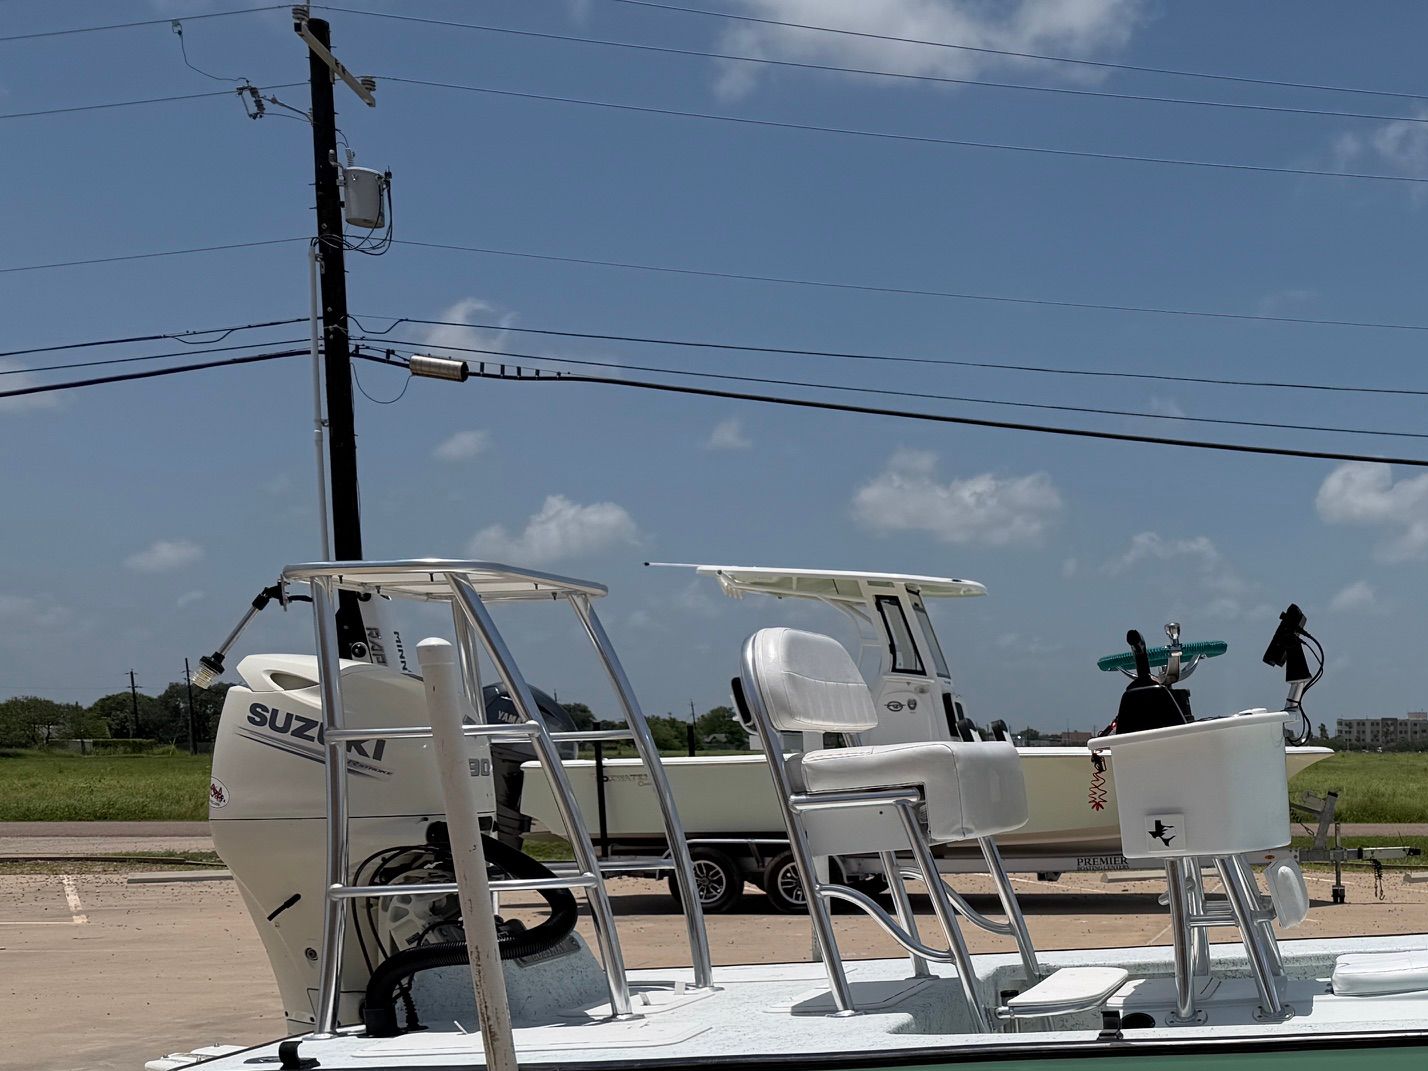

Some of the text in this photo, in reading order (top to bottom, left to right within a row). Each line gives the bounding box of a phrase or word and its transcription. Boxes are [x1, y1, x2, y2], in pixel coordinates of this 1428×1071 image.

[498, 710, 522, 724] YAMA
[247, 703, 386, 761] SUZKI
[1077, 857, 1129, 866] PREMIER
